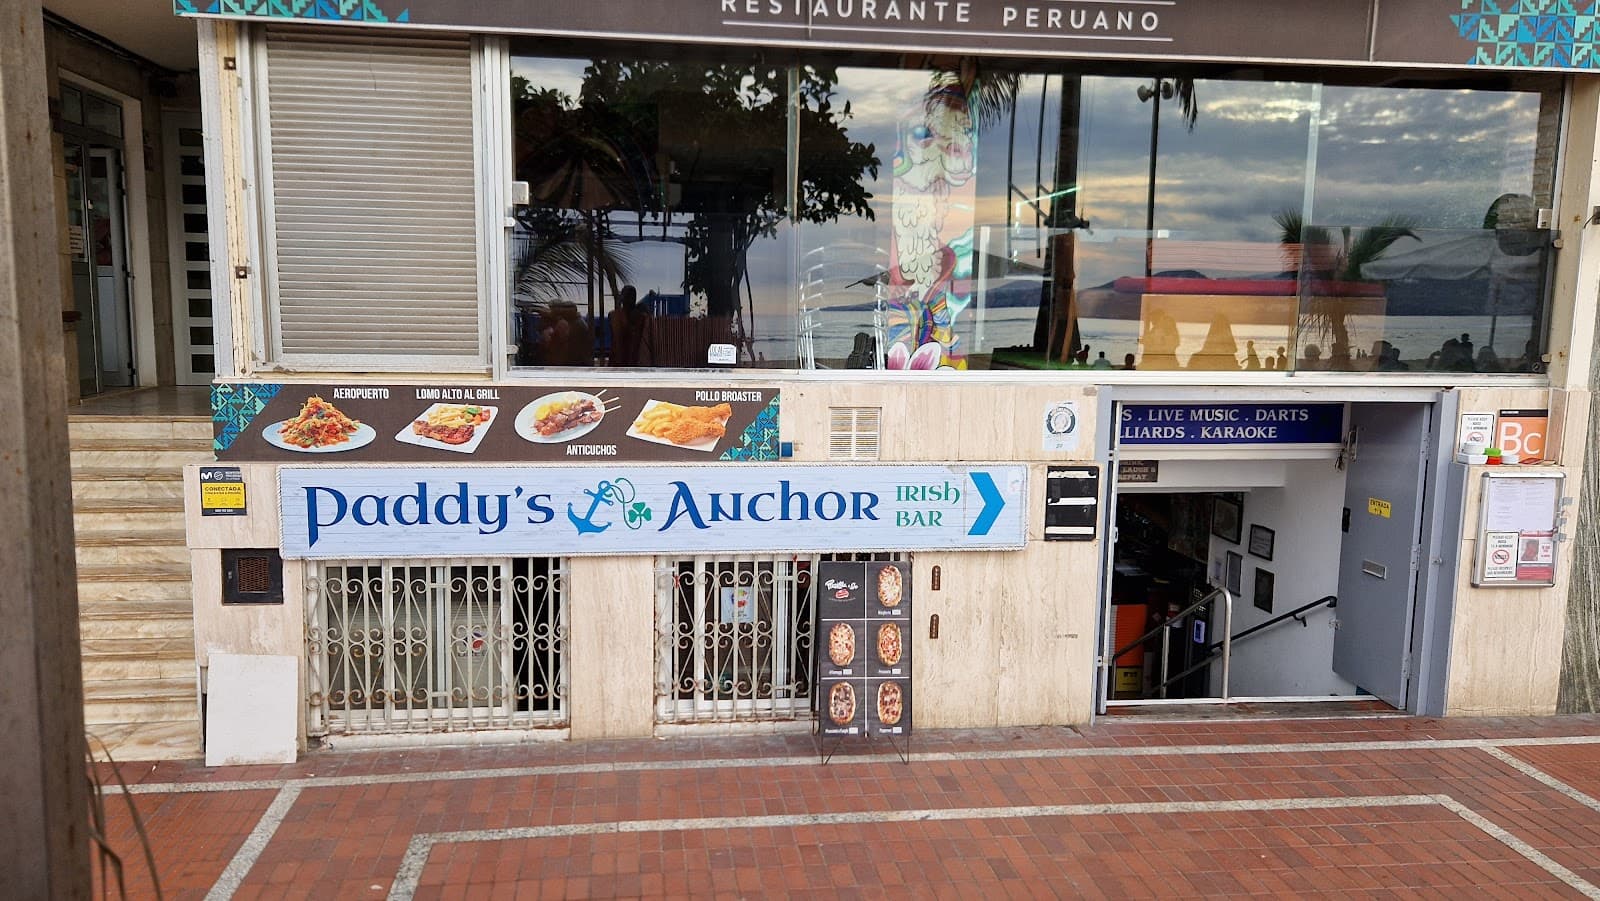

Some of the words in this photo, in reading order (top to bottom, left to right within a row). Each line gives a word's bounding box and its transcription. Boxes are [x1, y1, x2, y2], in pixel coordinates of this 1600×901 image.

[721, 0, 970, 22] RESTAURANTE
[1002, 7, 1159, 31] PERUANO
[333, 388, 389, 399] AEROPUERTO
[416, 388, 440, 400] LOMO
[441, 388, 462, 400] ALTO
[464, 388, 474, 400] AL
[476, 388, 500, 400] GRILL
[695, 390, 720, 402] POLLO
[721, 391, 762, 402] BROASTER
[1148, 409, 1184, 421] LIVE
[1190, 409, 1239, 421] MUSIC
[1255, 409, 1309, 421] DARTS
[1120, 427, 1185, 439] LIARDS
[1200, 427, 1277, 439] KARAOKE
[566, 444, 617, 456] ANTICUCHOS
[301, 481, 555, 549] Paddy's
[657, 480, 881, 532] Anchor
[896, 510, 943, 527] BAR
